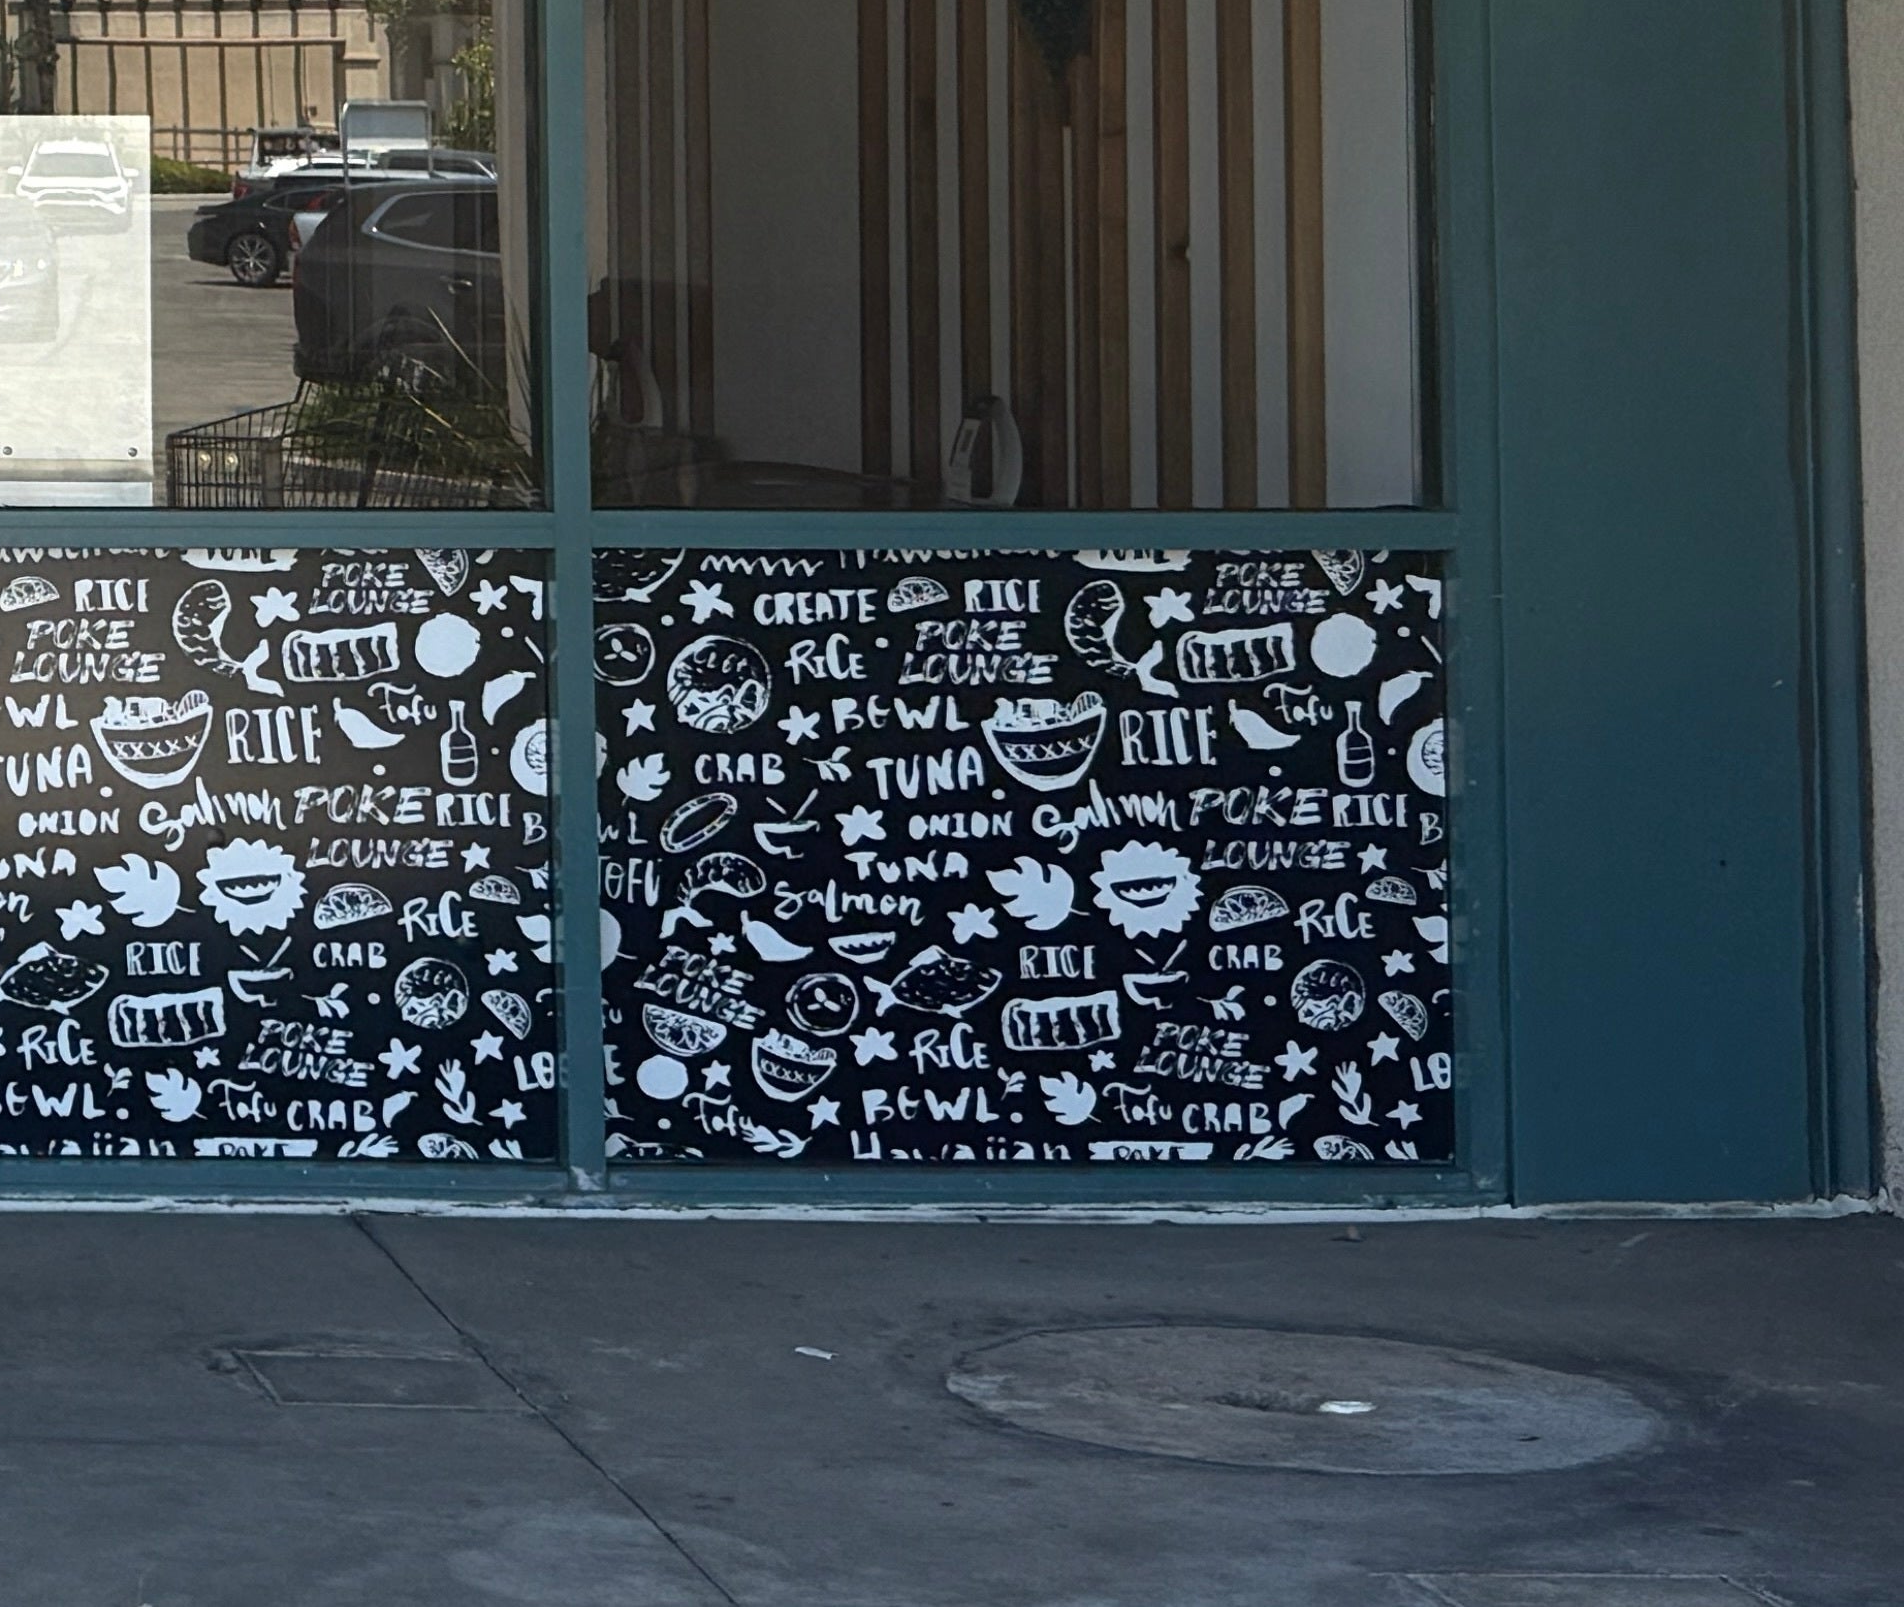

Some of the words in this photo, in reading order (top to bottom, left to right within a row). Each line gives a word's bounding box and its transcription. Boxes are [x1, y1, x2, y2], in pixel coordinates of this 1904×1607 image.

[754, 589, 877, 625] CREATE
[27, 619, 134, 650] POKE
[916, 619, 1026, 651] POKE
[10, 651, 165, 684] LOUNGE
[785, 633, 866, 684] RICE
[899, 652, 1058, 685] LOUNGE
[226, 705, 321, 764] RICE
[1120, 706, 1216, 765] RICE
[695, 754, 785, 784] CRAB
[866, 746, 984, 800] TUNA
[294, 784, 431, 825] POKE
[1189, 786, 1328, 826] POKE
[306, 838, 453, 868] LOUNGE
[853, 850, 968, 883] TUNA
[1201, 840, 1350, 870] LOUNGE
[398, 891, 478, 942] RICE
[774, 879, 923, 925] Salmon
[1294, 892, 1375, 944] RICE
[313, 943, 386, 968] CRAB
[1209, 945, 1283, 970] CRAB
[287, 1100, 376, 1131] CRAB
[1182, 1103, 1272, 1134] CRAB
